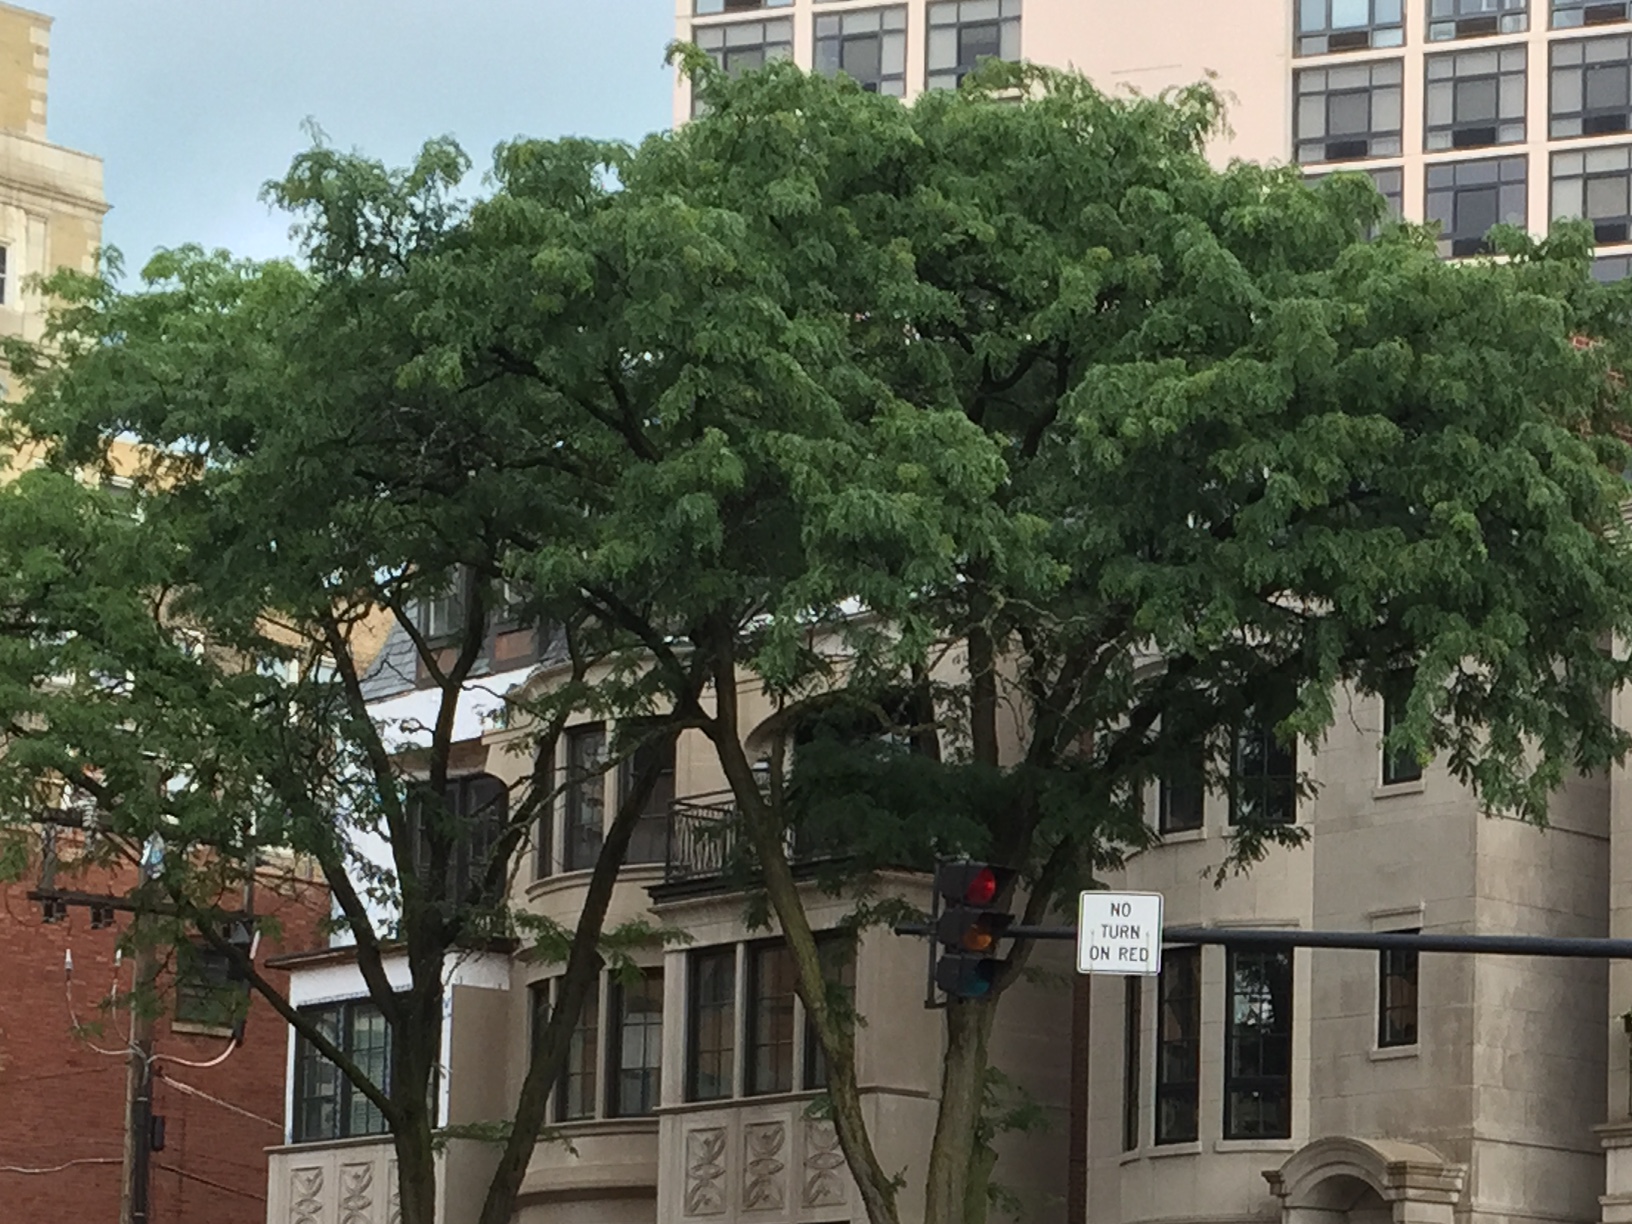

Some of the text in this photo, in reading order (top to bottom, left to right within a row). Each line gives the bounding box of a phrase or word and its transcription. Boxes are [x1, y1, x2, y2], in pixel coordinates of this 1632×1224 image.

[1110, 902, 1132, 917] NO
[1101, 924, 1141, 939] TURN
[1089, 945, 1149, 962] ON RED
